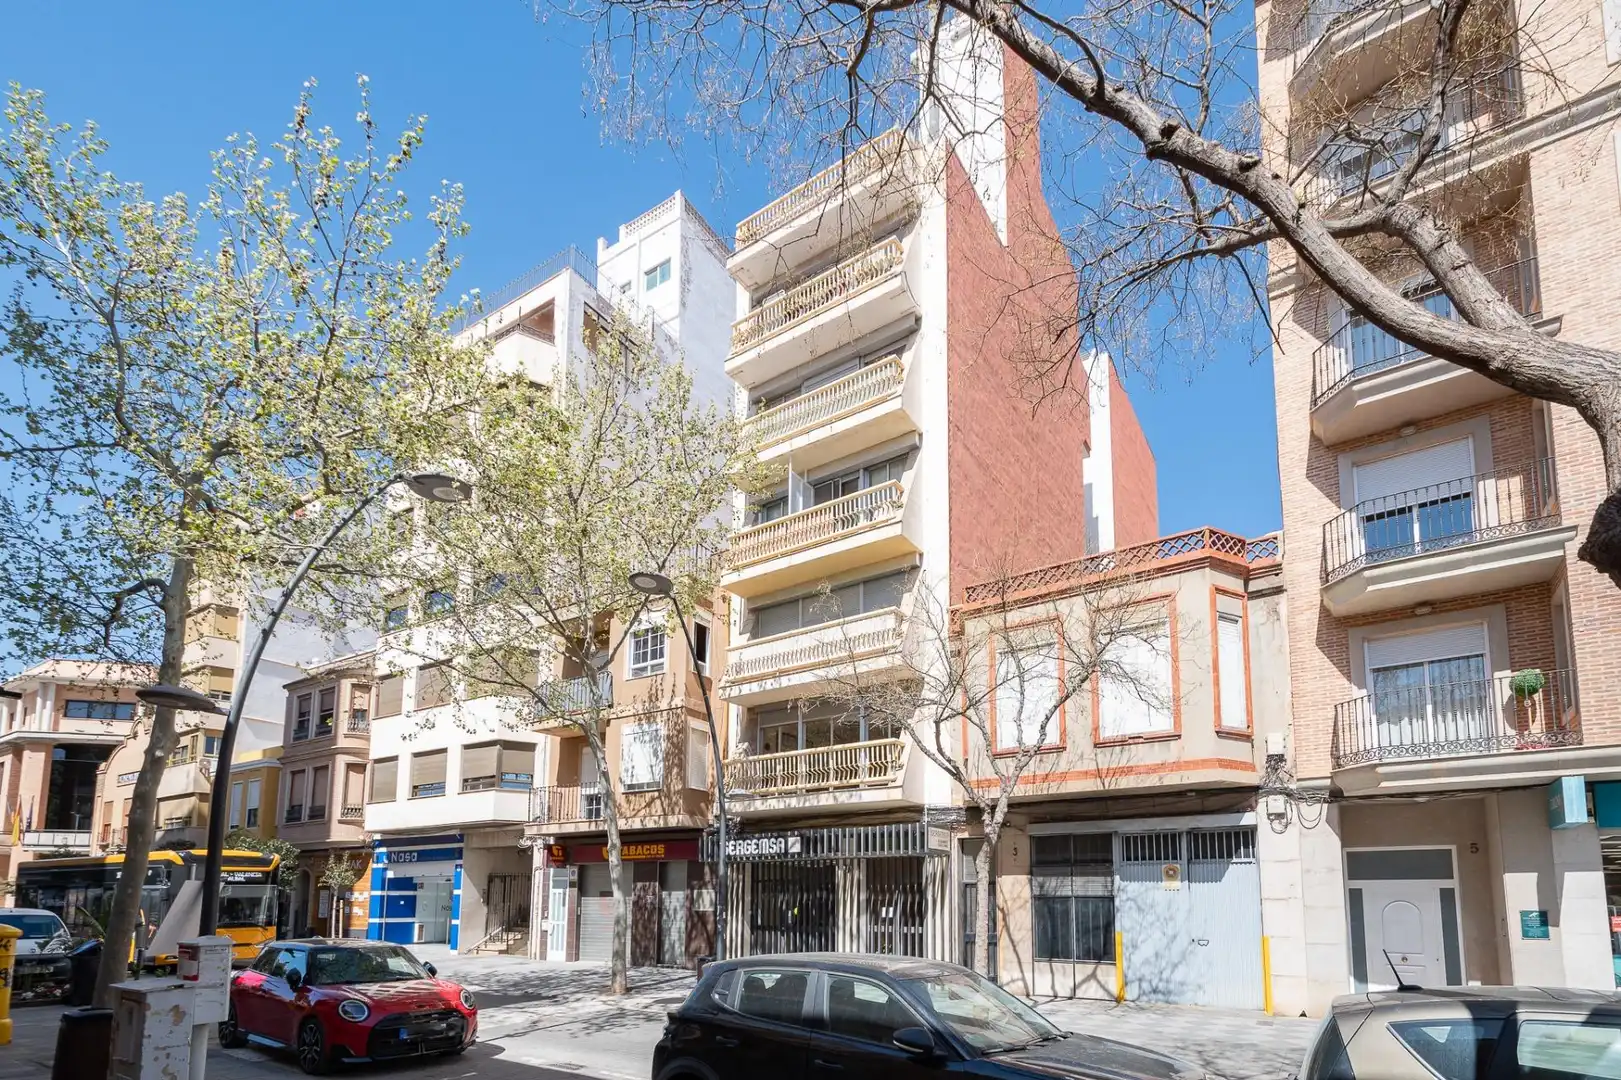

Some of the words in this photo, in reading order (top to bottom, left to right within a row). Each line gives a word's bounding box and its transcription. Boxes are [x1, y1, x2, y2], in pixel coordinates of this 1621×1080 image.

[620, 843, 665, 856] ABACOS
[1012, 847, 1018, 856] 3
[1470, 843, 1479, 854] 5
[391, 852, 418, 863] Nasa
